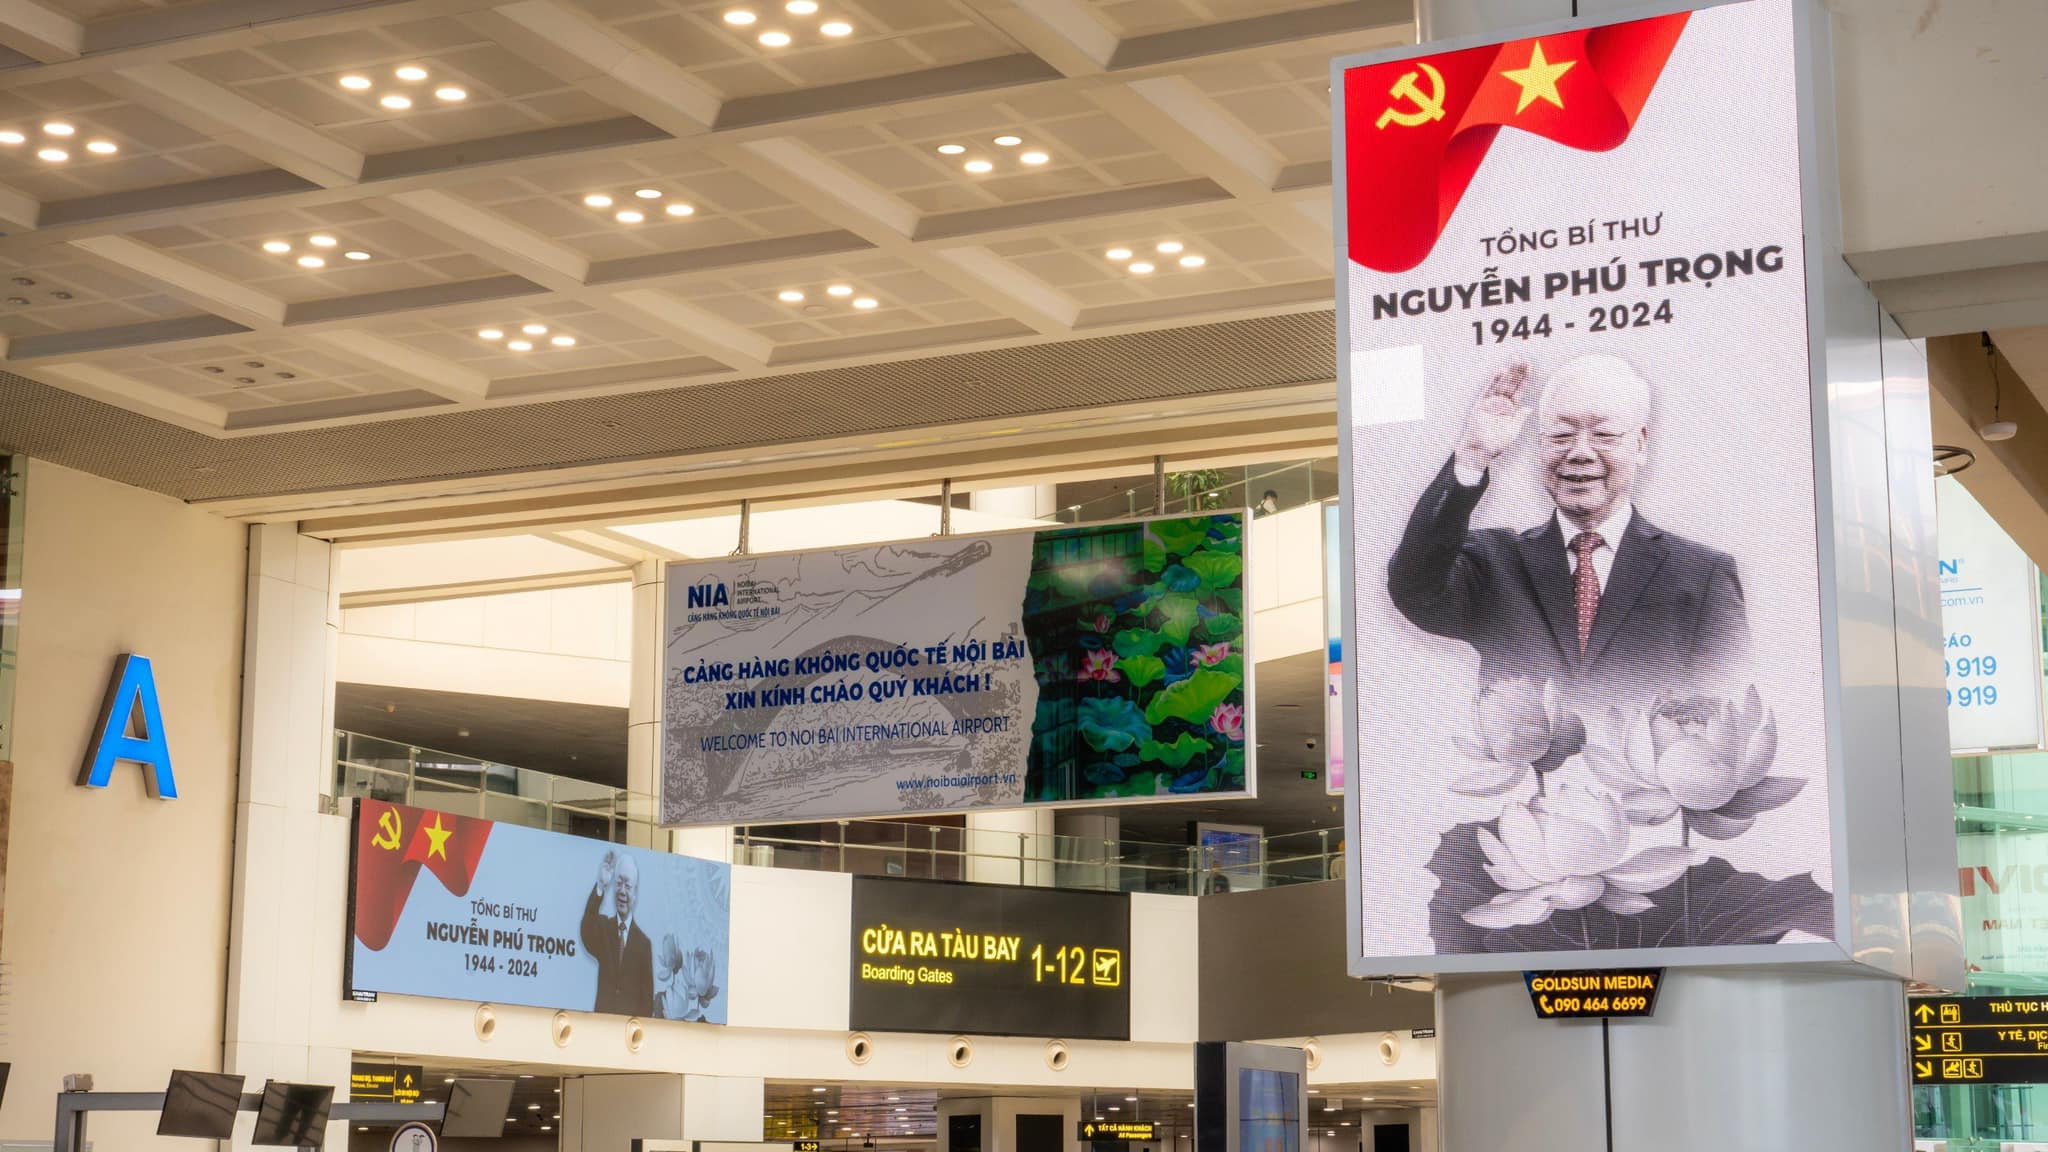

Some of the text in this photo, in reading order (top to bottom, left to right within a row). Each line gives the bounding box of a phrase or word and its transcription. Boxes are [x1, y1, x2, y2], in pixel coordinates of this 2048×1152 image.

[1480, 211, 1663, 257] TỔNG BÍ THƯ
[1373, 245, 1784, 320] NGUYỄN PHÚ TRỌNG
[1471, 313, 1553, 346] 1944
[1589, 298, 1674, 332] 2024
[688, 583, 728, 608] NIA
[684, 635, 1025, 684] CẢNG HÀNG KHÔNG QUỐC TẾ NỘI BÀI
[1956, 655, 1998, 678] 919
[725, 671, 991, 710] XIN KÍNH CHÀO QUÝ KHÁCH !
[1957, 685, 1998, 707] 919
[76, 653, 177, 800] A
[700, 716, 1010, 752] WELCOME TO NOI BAI INTERNATIONAL AIRPORT
[896, 772, 1016, 791] www.noibaiairport.vn
[471, 897, 538, 922] TỔNG BÍ THƯ
[426, 918, 576, 960] NGUYỄN PHÚ TRỌNG
[862, 924, 1021, 961] CỬA RA TÀU BAY
[465, 953, 495, 973] 1944
[508, 958, 538, 978] 2024
[861, 963, 953, 985] Boarding Gates
[1031, 944, 1085, 985] 1-12
[1531, 975, 1654, 992] GOLDSUN MEDIA
[1554, 996, 1647, 1012] 090 464 6699
[1989, 1001, 2013, 1013] THỦ
[2015, 1002, 2039, 1014] TỤC
[1998, 1031, 2006, 1041] Y
